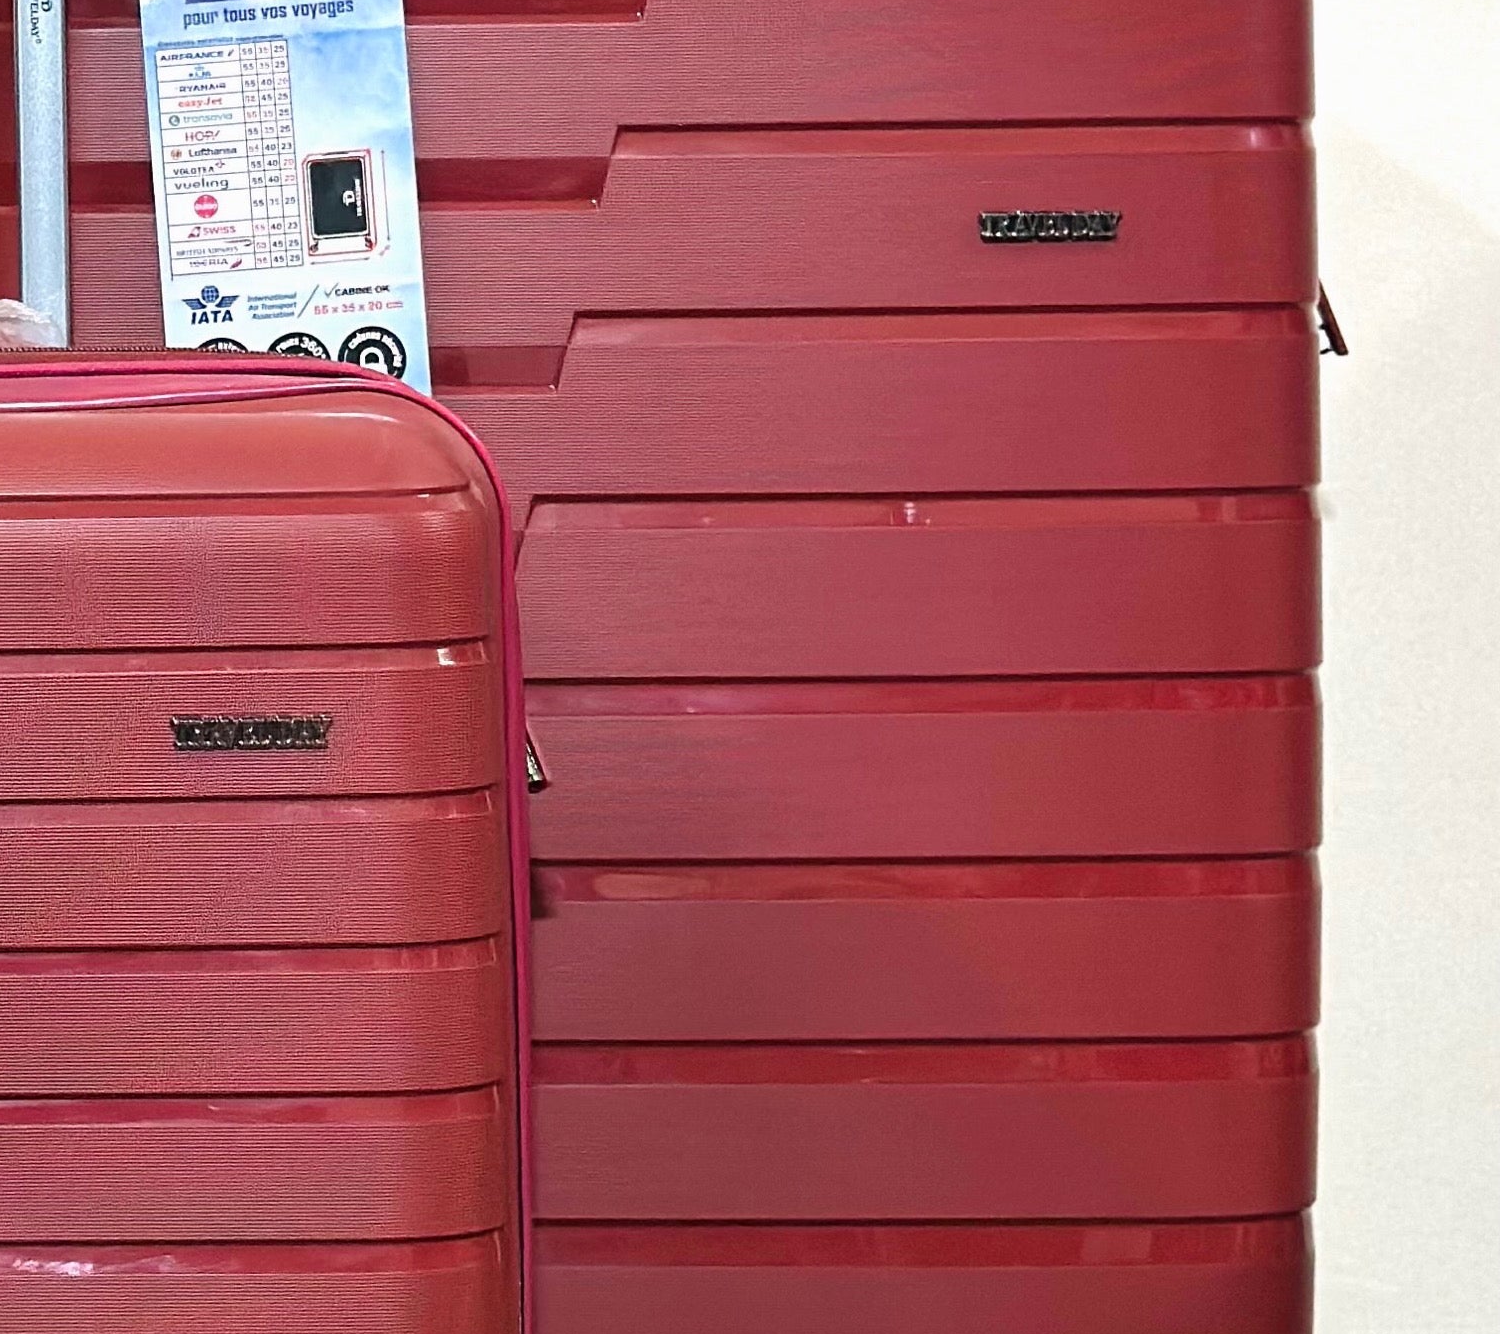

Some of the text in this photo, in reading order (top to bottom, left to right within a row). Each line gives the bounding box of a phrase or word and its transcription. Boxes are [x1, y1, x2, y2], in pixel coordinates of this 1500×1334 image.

[183, 0, 353, 29] pour tous vos voyages
[191, 310, 234, 325] IATA
